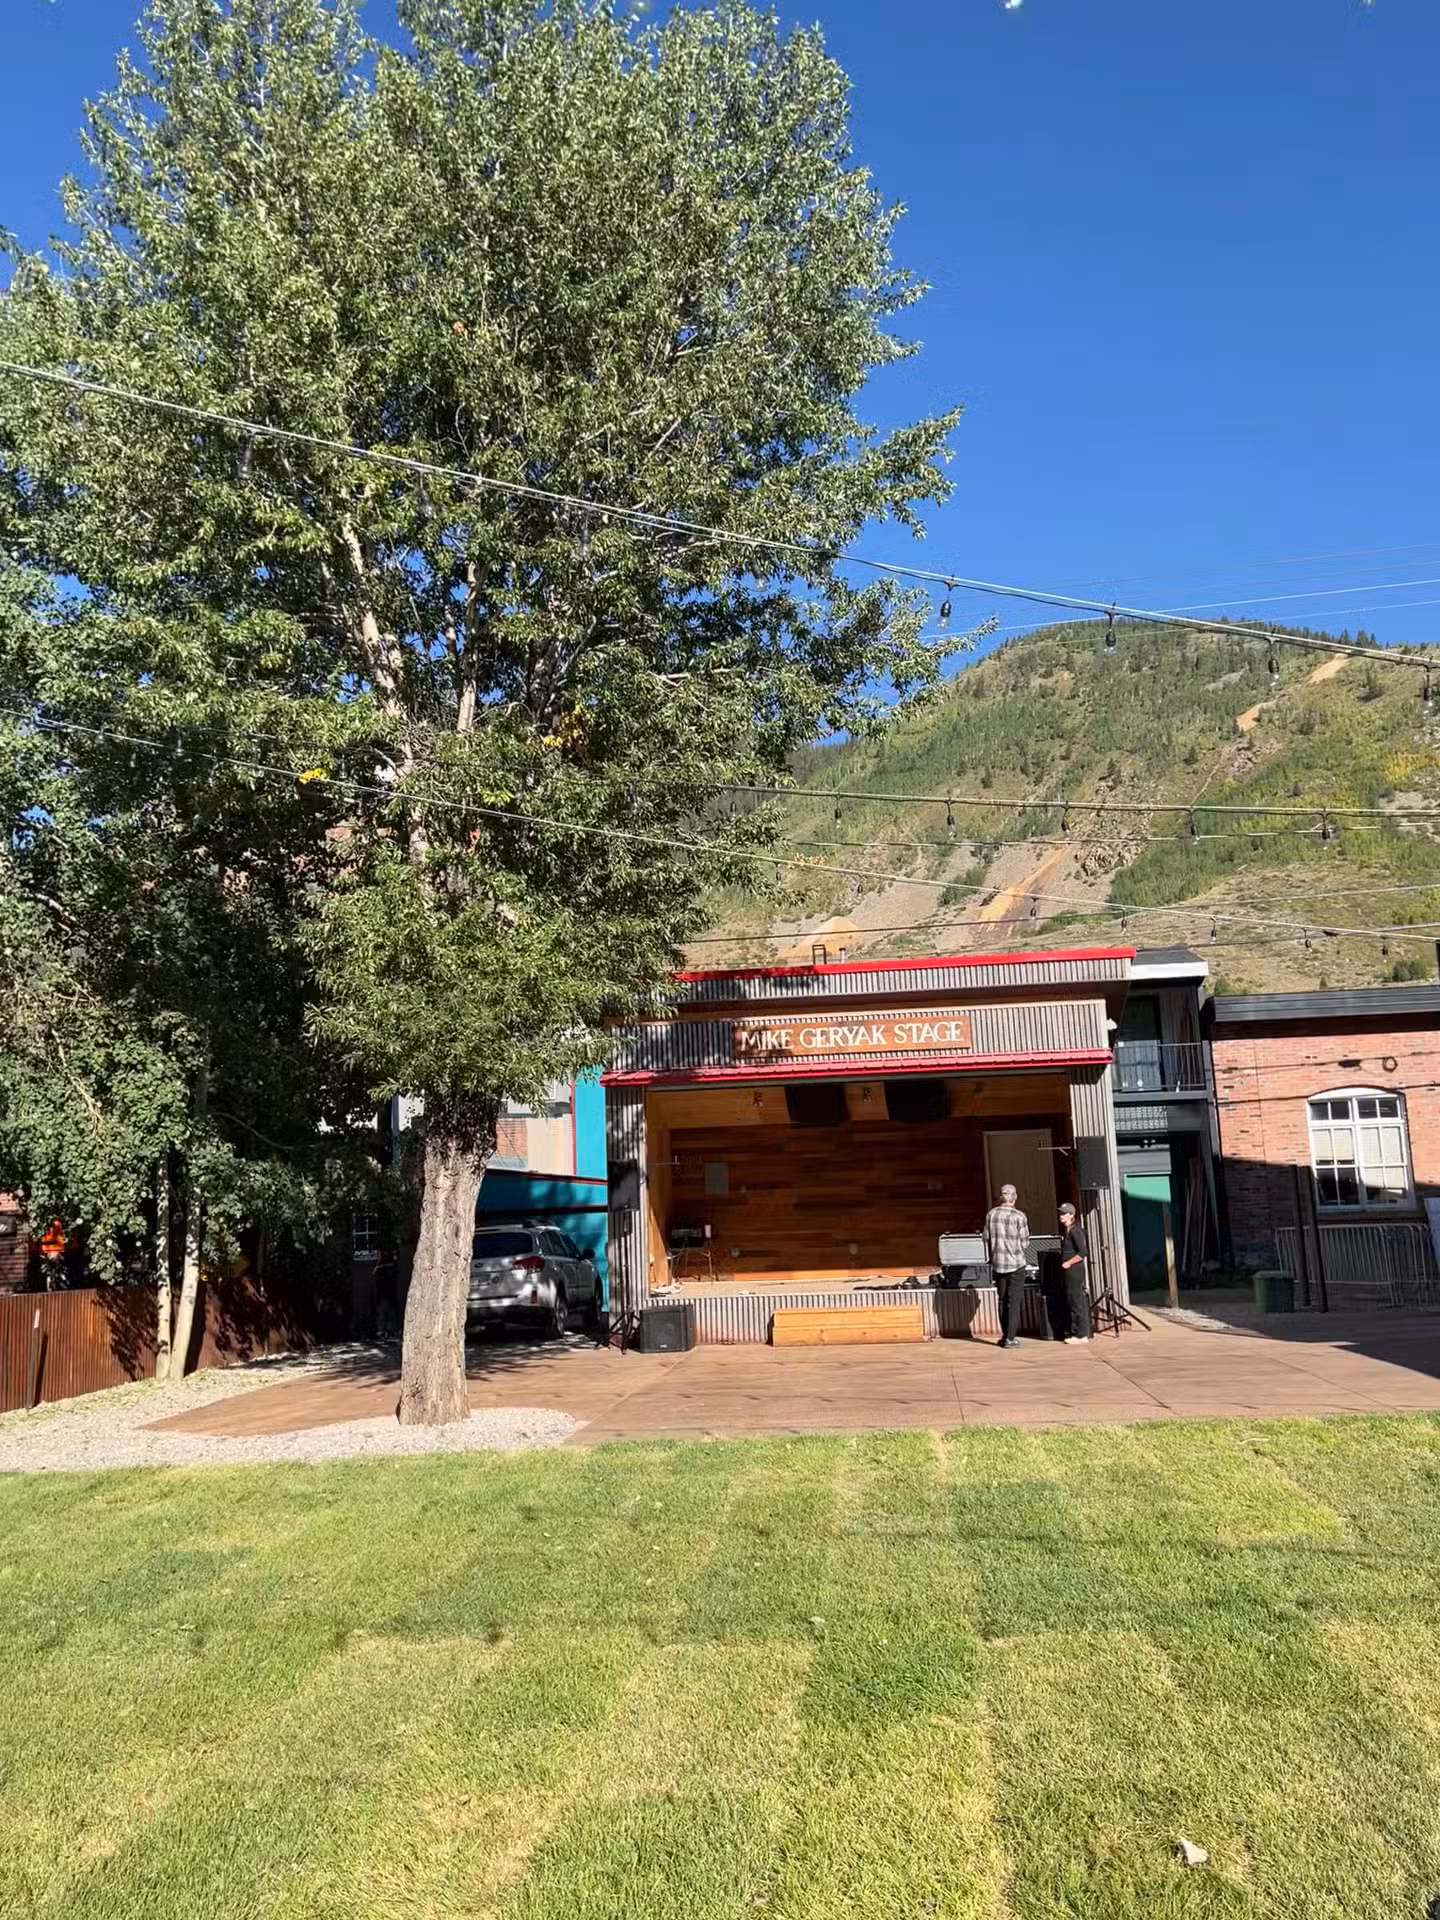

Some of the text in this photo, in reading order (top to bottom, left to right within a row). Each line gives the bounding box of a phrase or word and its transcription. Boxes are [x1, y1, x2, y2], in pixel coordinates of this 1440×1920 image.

[741, 1021, 964, 1051] MIKE GERYAK STAGE
